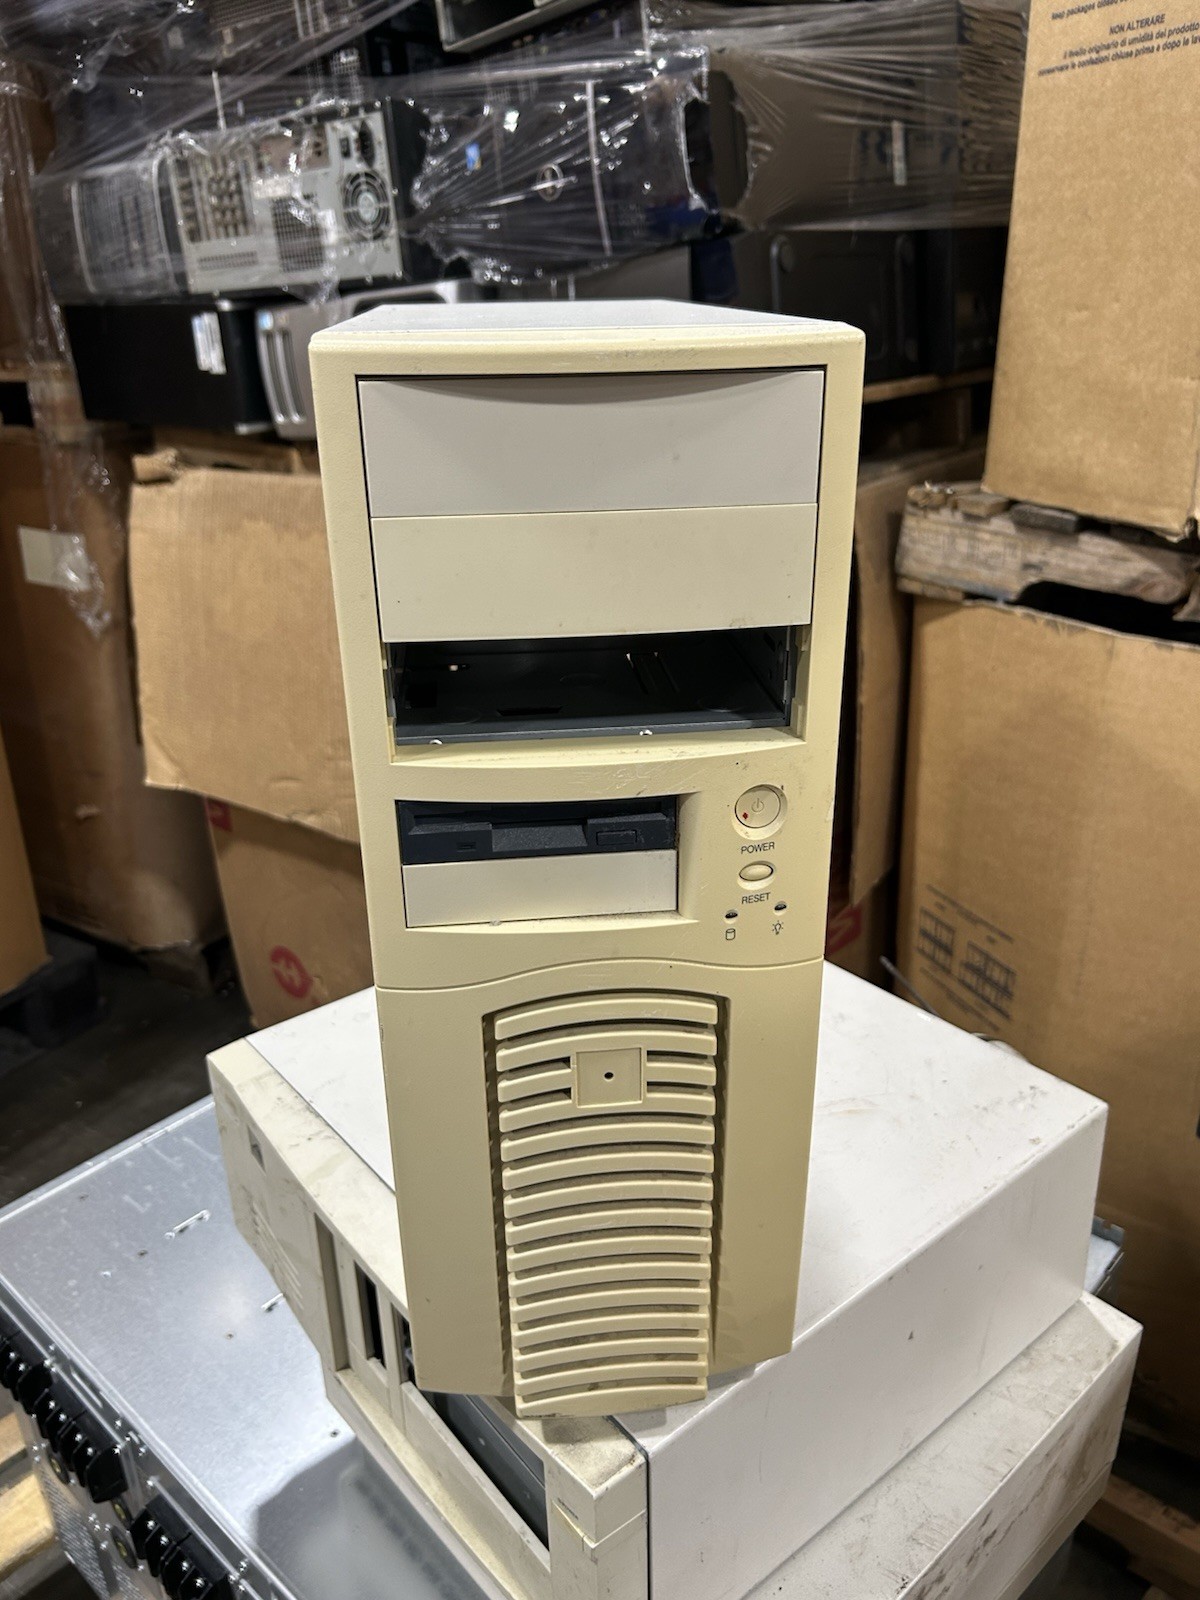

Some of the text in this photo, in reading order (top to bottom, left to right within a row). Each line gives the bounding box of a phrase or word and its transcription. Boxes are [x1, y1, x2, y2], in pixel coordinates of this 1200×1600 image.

[1109, 14, 1165, 35] NON ALTERARE
[1155, 28, 1167, 39] del
[1168, 22, 1200, 38] prodotto
[1156, 44, 1161, 52] e
[1162, 39, 1181, 51] dopo
[740, 841, 775, 854] POWER
[741, 892, 771, 904] RESET
